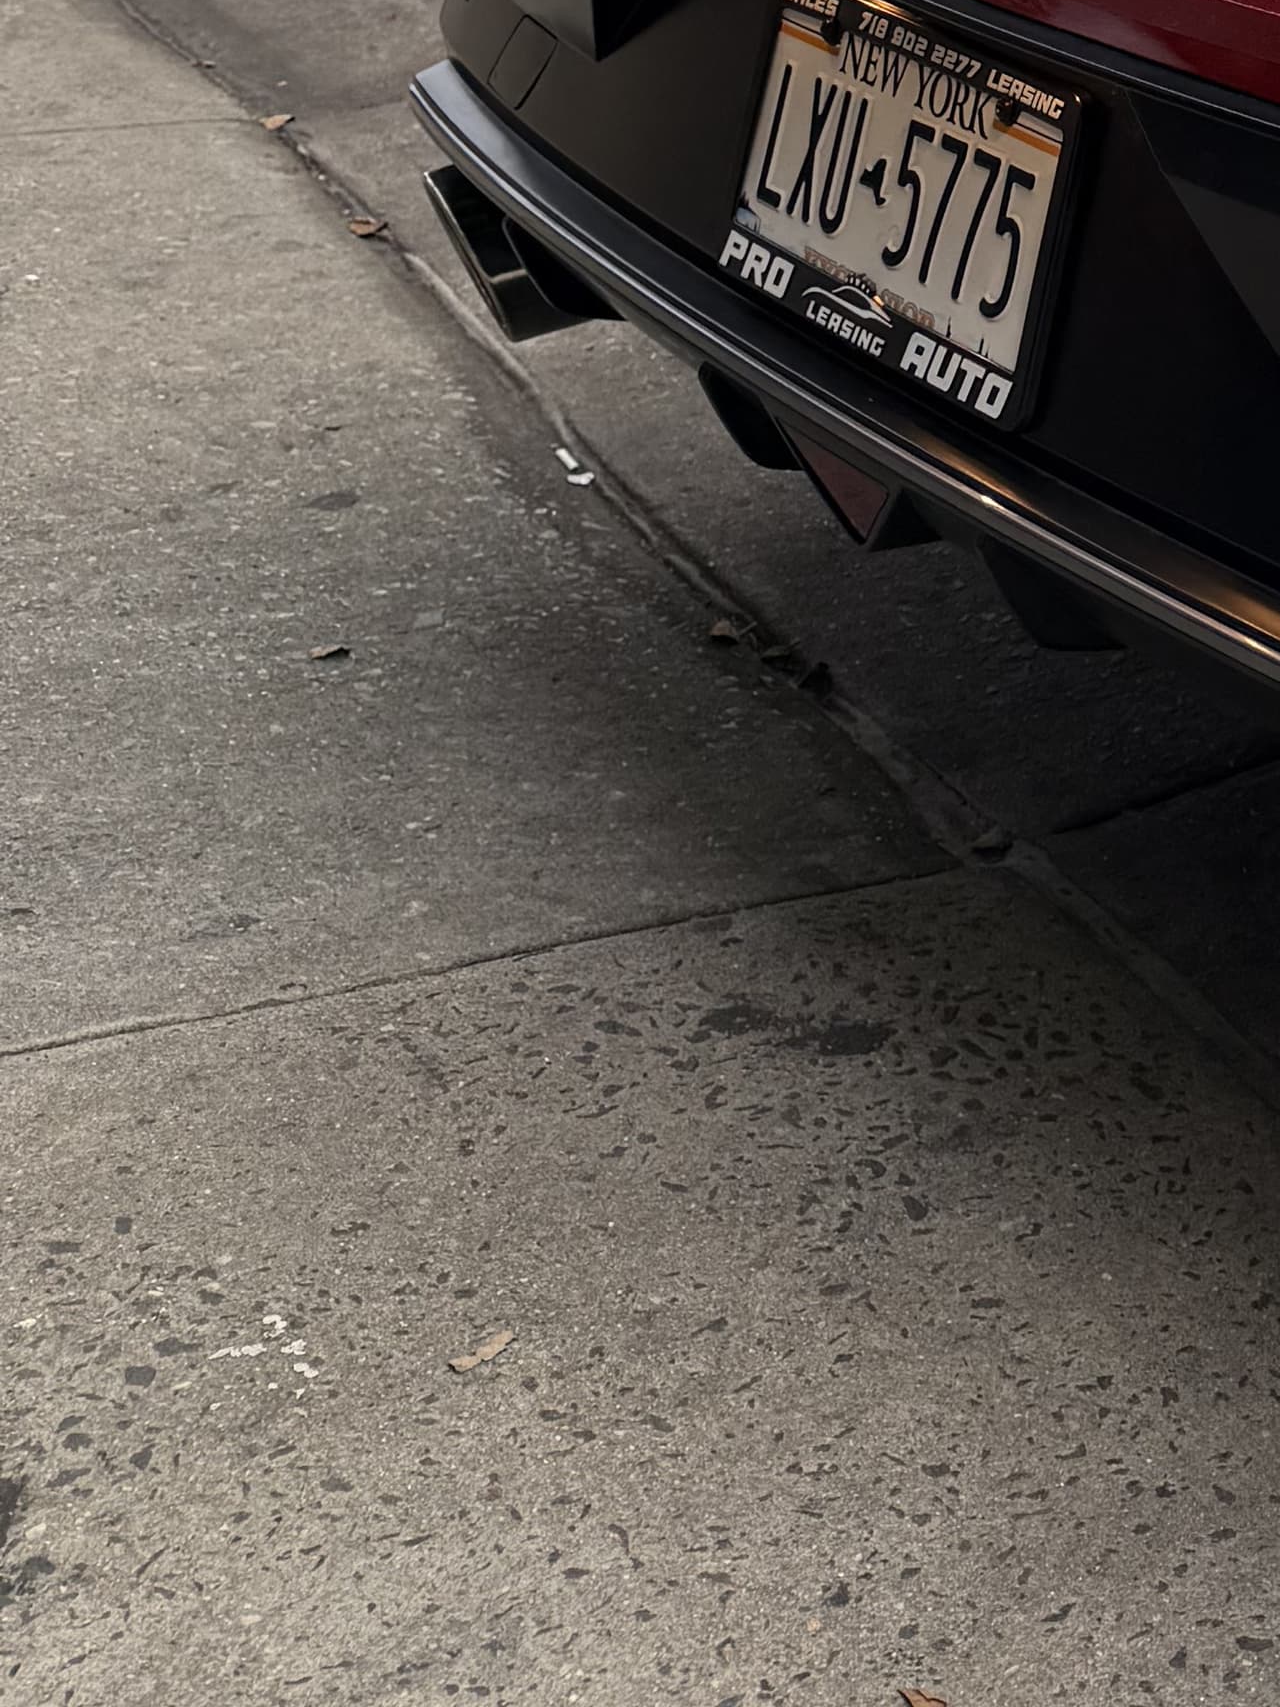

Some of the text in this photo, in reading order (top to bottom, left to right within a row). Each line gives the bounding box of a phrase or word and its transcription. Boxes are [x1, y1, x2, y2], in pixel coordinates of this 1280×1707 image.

[840, 33, 992, 140] NEW YORK
[858, 11, 887, 37] 718
[930, 45, 983, 79] 2277
[986, 68, 1065, 120] LEASING
[757, 64, 1036, 319] LXU 5775
[718, 229, 1014, 420] PRO LEASING AUTO
